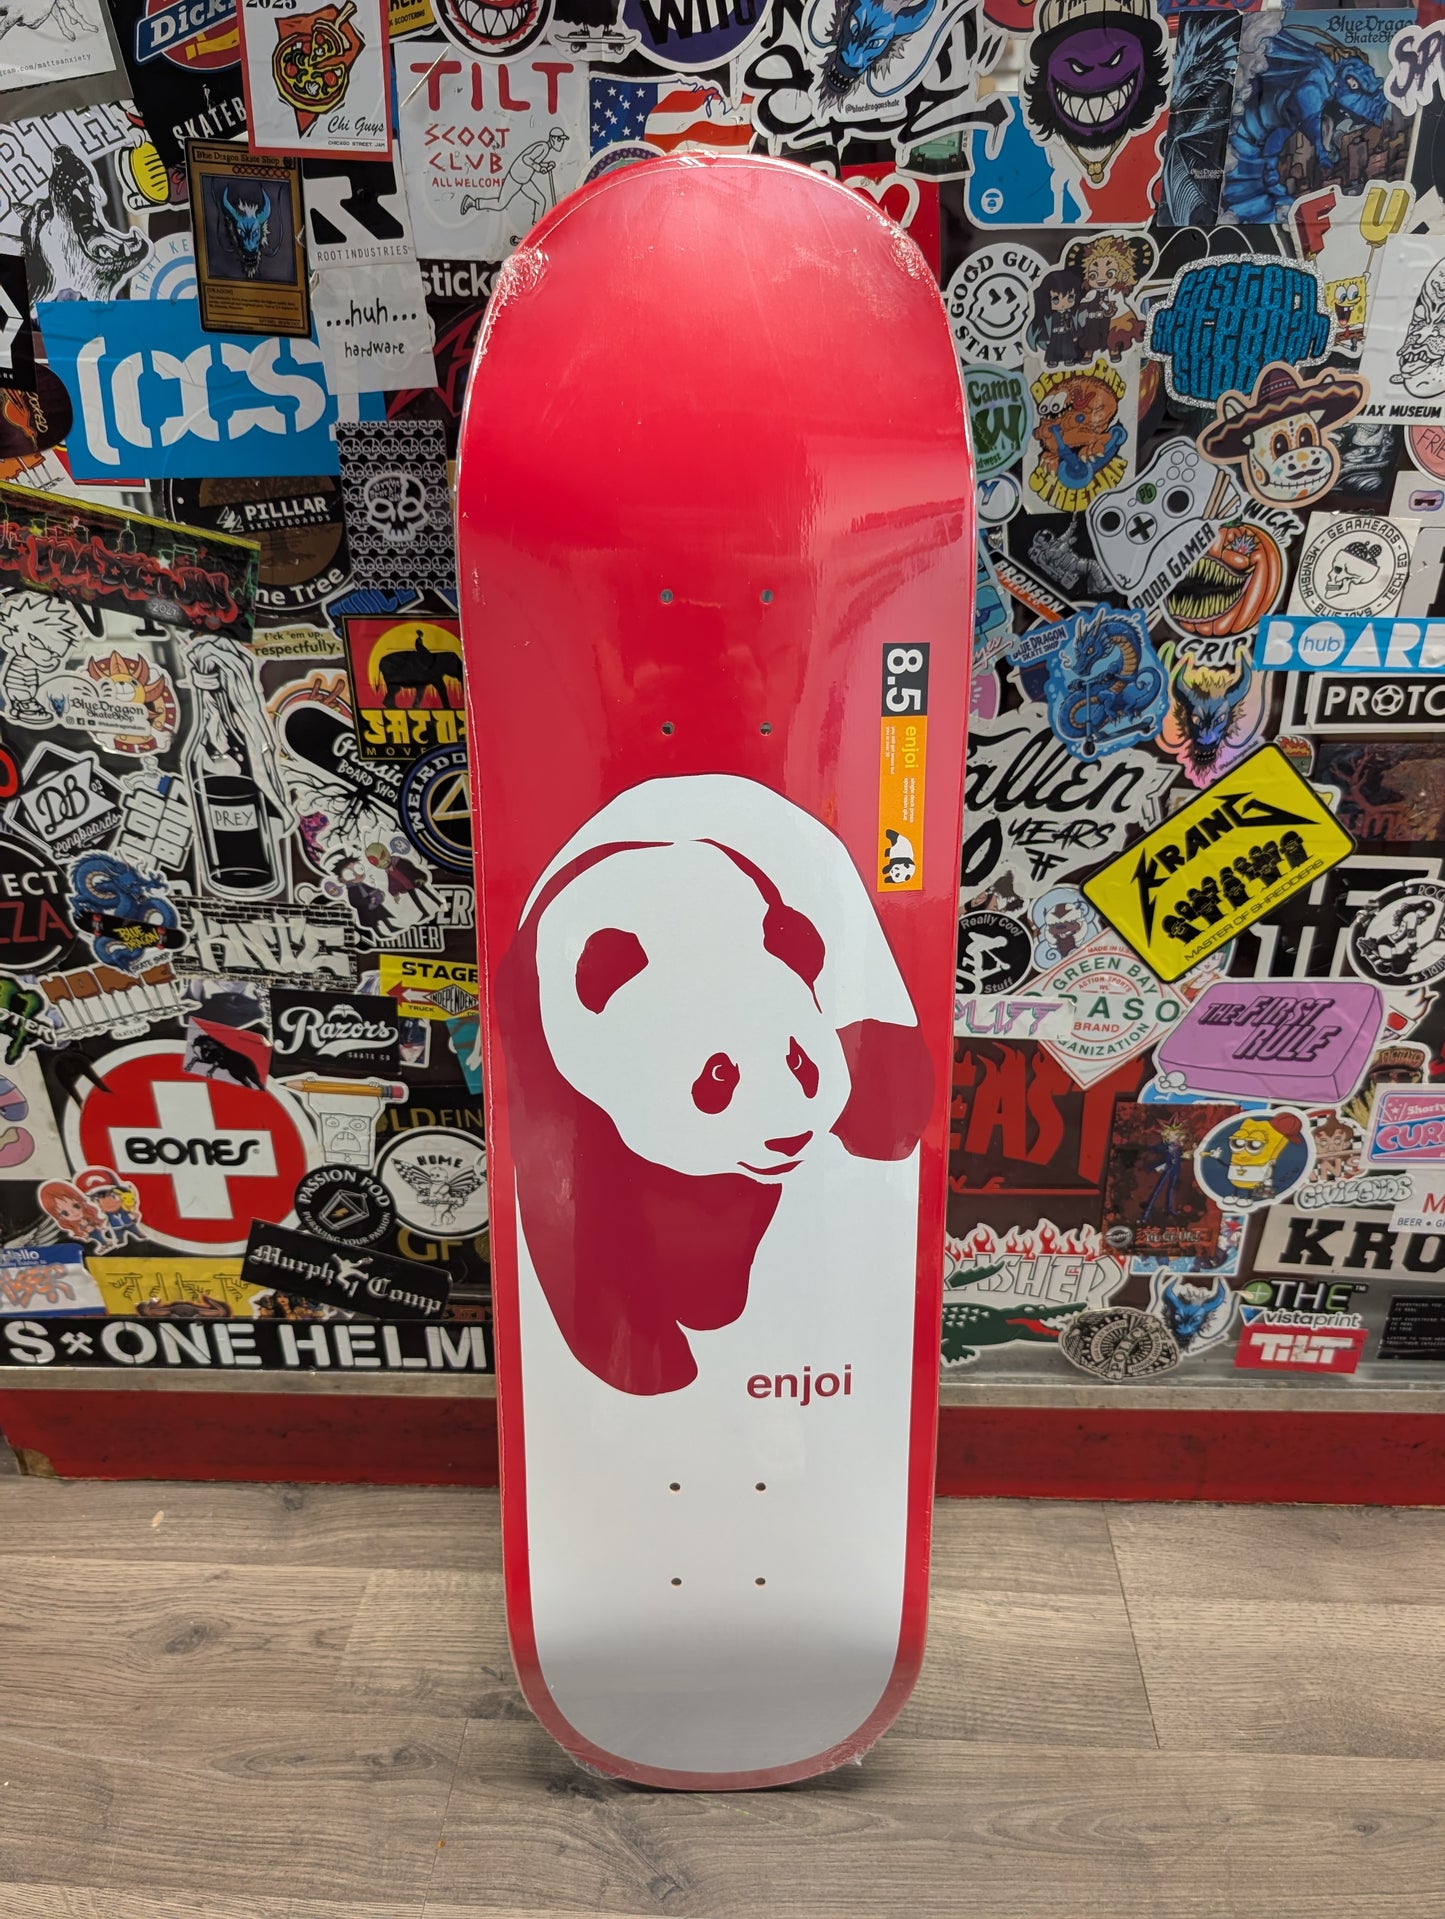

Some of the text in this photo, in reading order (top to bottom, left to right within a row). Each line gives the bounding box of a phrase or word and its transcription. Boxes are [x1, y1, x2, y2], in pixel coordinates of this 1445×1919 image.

[410, 61, 574, 114] TILT
[327, 115, 386, 137] Chi Guys
[425, 123, 510, 149] SCOOT
[214, 152, 240, 164] Dragon
[428, 152, 504, 174] CLUB
[951, 254, 995, 318] GOOD
[345, 341, 405, 358] hardware
[955, 325, 1005, 362] STAY
[1389, 405, 1442, 418] MUSEUM
[250, 514, 332, 530] SKATEBOARDS
[1327, 519, 1401, 544] GEARHEADS
[1167, 522, 1217, 578] GAMER
[291, 566, 345, 603] Tree
[994, 560, 1065, 614] BRONSON
[1301, 546, 1321, 599] MENASHA
[254, 637, 341, 658] respectfully.
[1030, 627, 1067, 649] DRAGON
[1302, 636, 1341, 653] hub
[886, 648, 923, 713] 8.5
[902, 725, 919, 769] enjoi
[336, 762, 373, 788] BOARD
[214, 808, 255, 827] PREY
[1007, 818, 1116, 850] YEARS
[1184, 858, 1325, 962] MASTER OF SHREDDERS
[960, 914, 1024, 937] Really Cool
[983, 976, 1015, 994] Stuff
[1052, 957, 1158, 994] GREEN BAY
[1073, 1022, 1120, 1032] BRAND
[1199, 996, 1335, 1029] THE FIRST
[273, 1005, 399, 1056] Razors
[1233, 1023, 1341, 1062] RULE
[417, 1154, 463, 1169] HOME
[298, 1169, 390, 1207] PASSION POD
[1397, 1217, 1422, 1227] BEER
[366, 1276, 442, 1316] Comp
[1271, 1280, 1353, 1312] THE
[1265, 1309, 1360, 1329] vistaprint
[747, 1363, 852, 1407] enjoi
